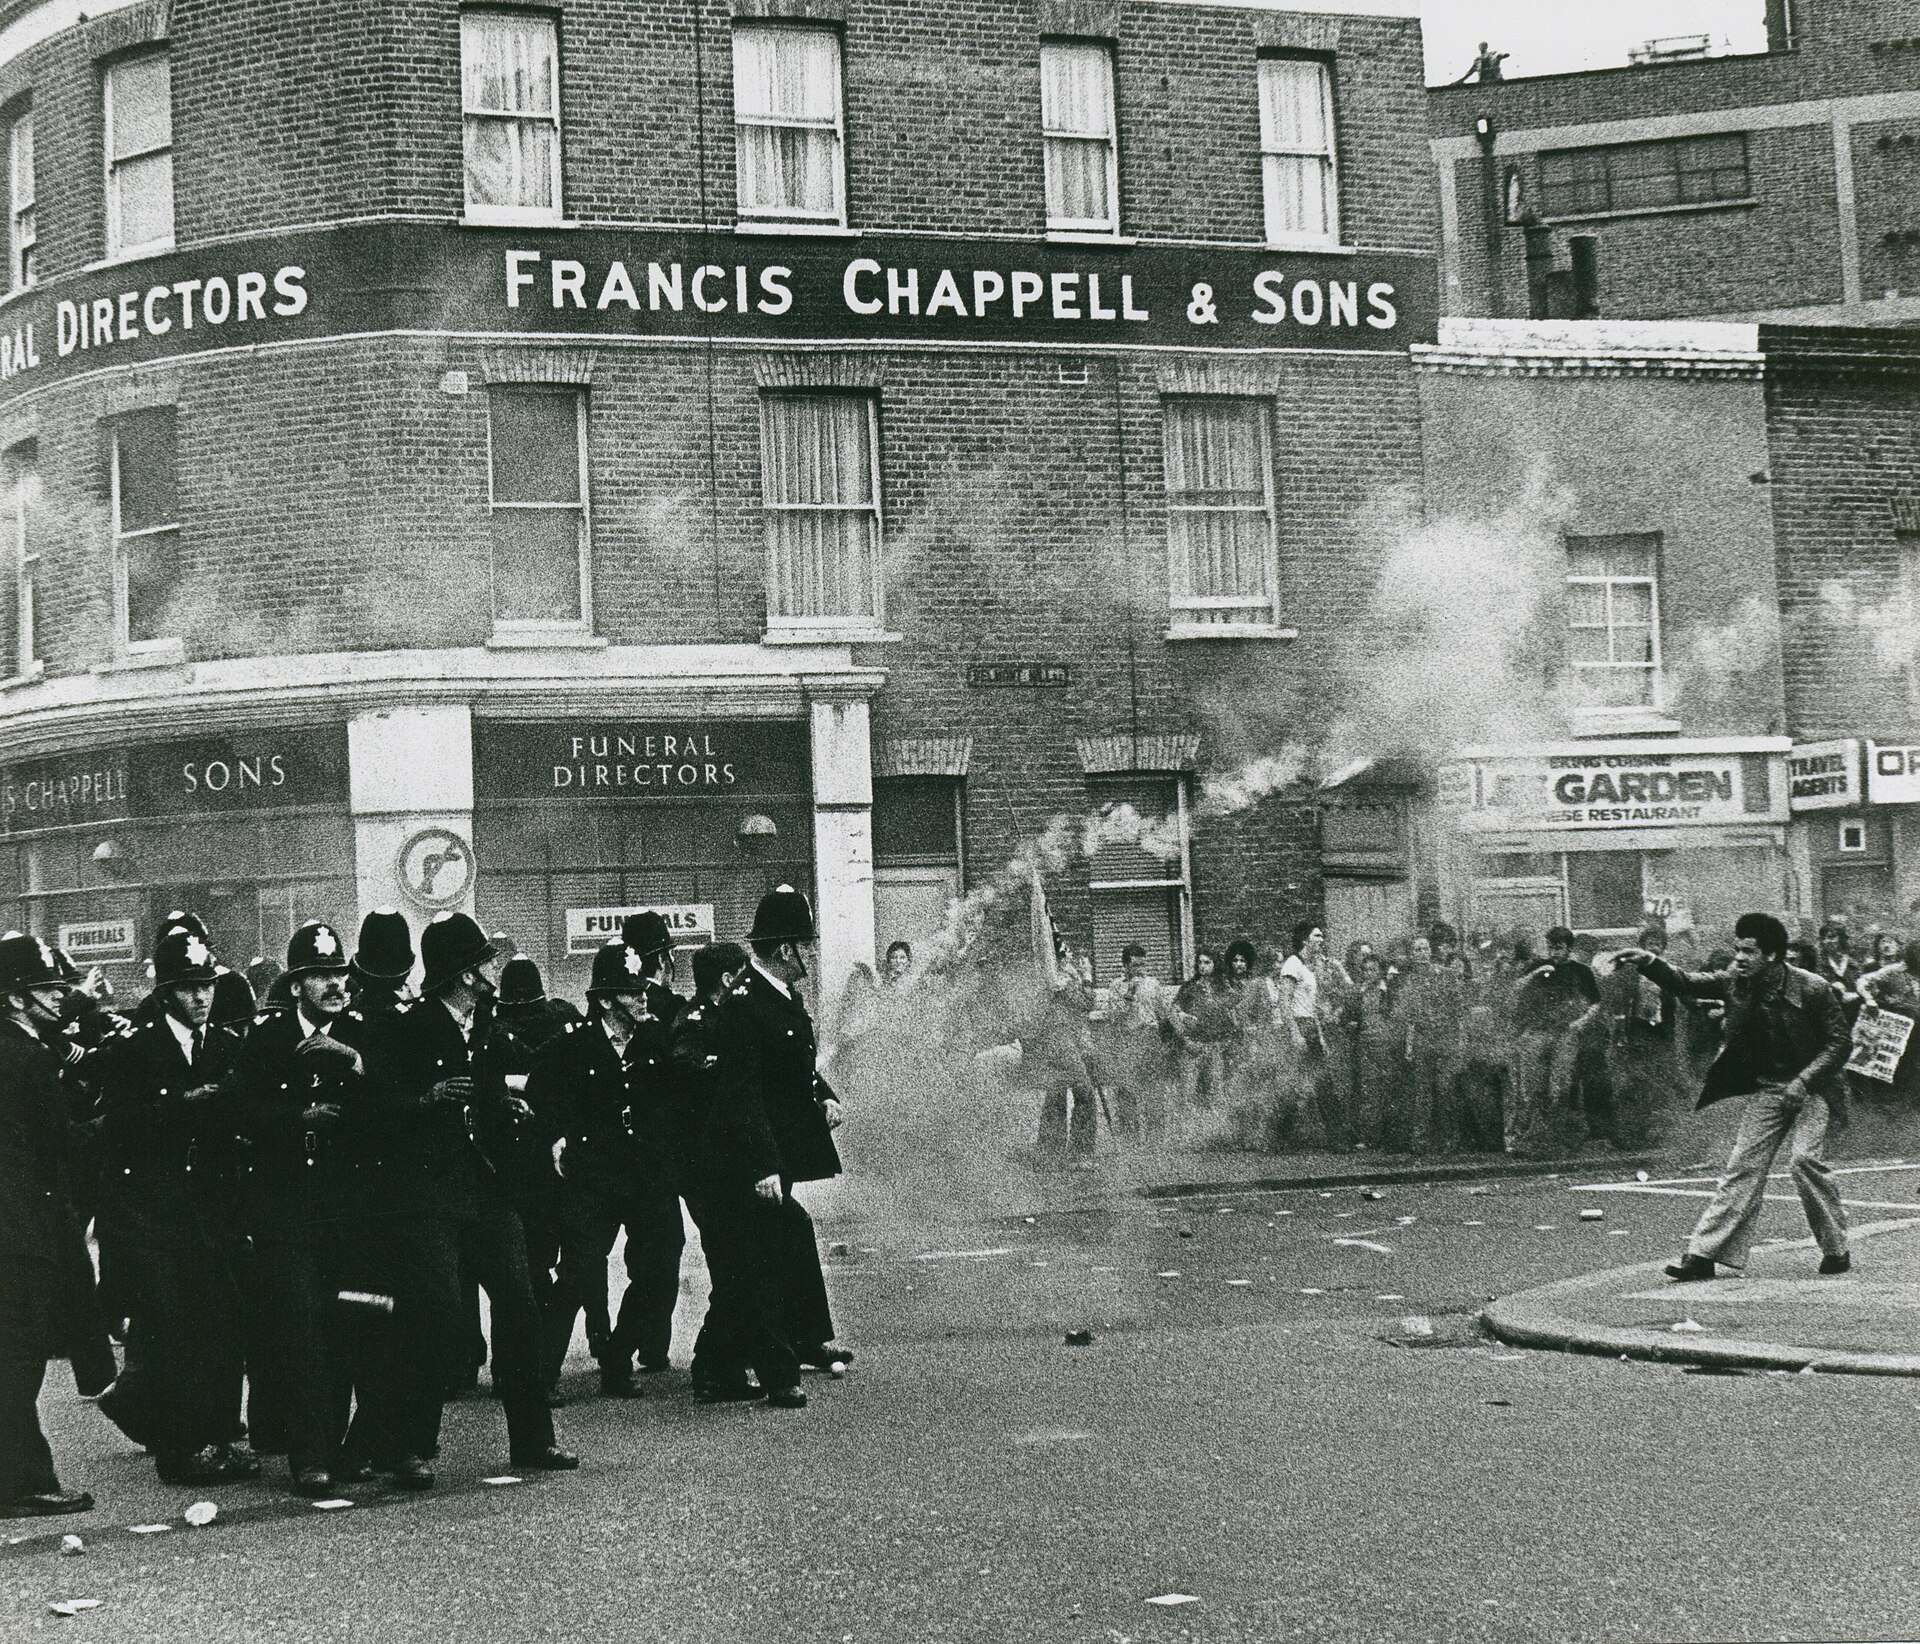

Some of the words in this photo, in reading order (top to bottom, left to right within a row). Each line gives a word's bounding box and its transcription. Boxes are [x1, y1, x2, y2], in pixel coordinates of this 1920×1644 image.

[506, 250, 793, 315] FRANCIS
[843, 258, 1149, 321] CHAPPELL
[1187, 283, 1219, 325] &
[1251, 271, 1397, 329] SONS
[57, 267, 308, 357] DIRECTORS
[572, 735, 716, 758] FUNERAL
[25, 770, 127, 810] CHAPPELL
[183, 756, 285, 793] SONS
[554, 763, 736, 787] DIRECTORS
[1555, 771, 1731, 803] GARDEN
[1588, 807, 1700, 821] RESTAURANT
[586, 903, 697, 931] FUNALS
[68, 927, 125, 946] FUNERALS
